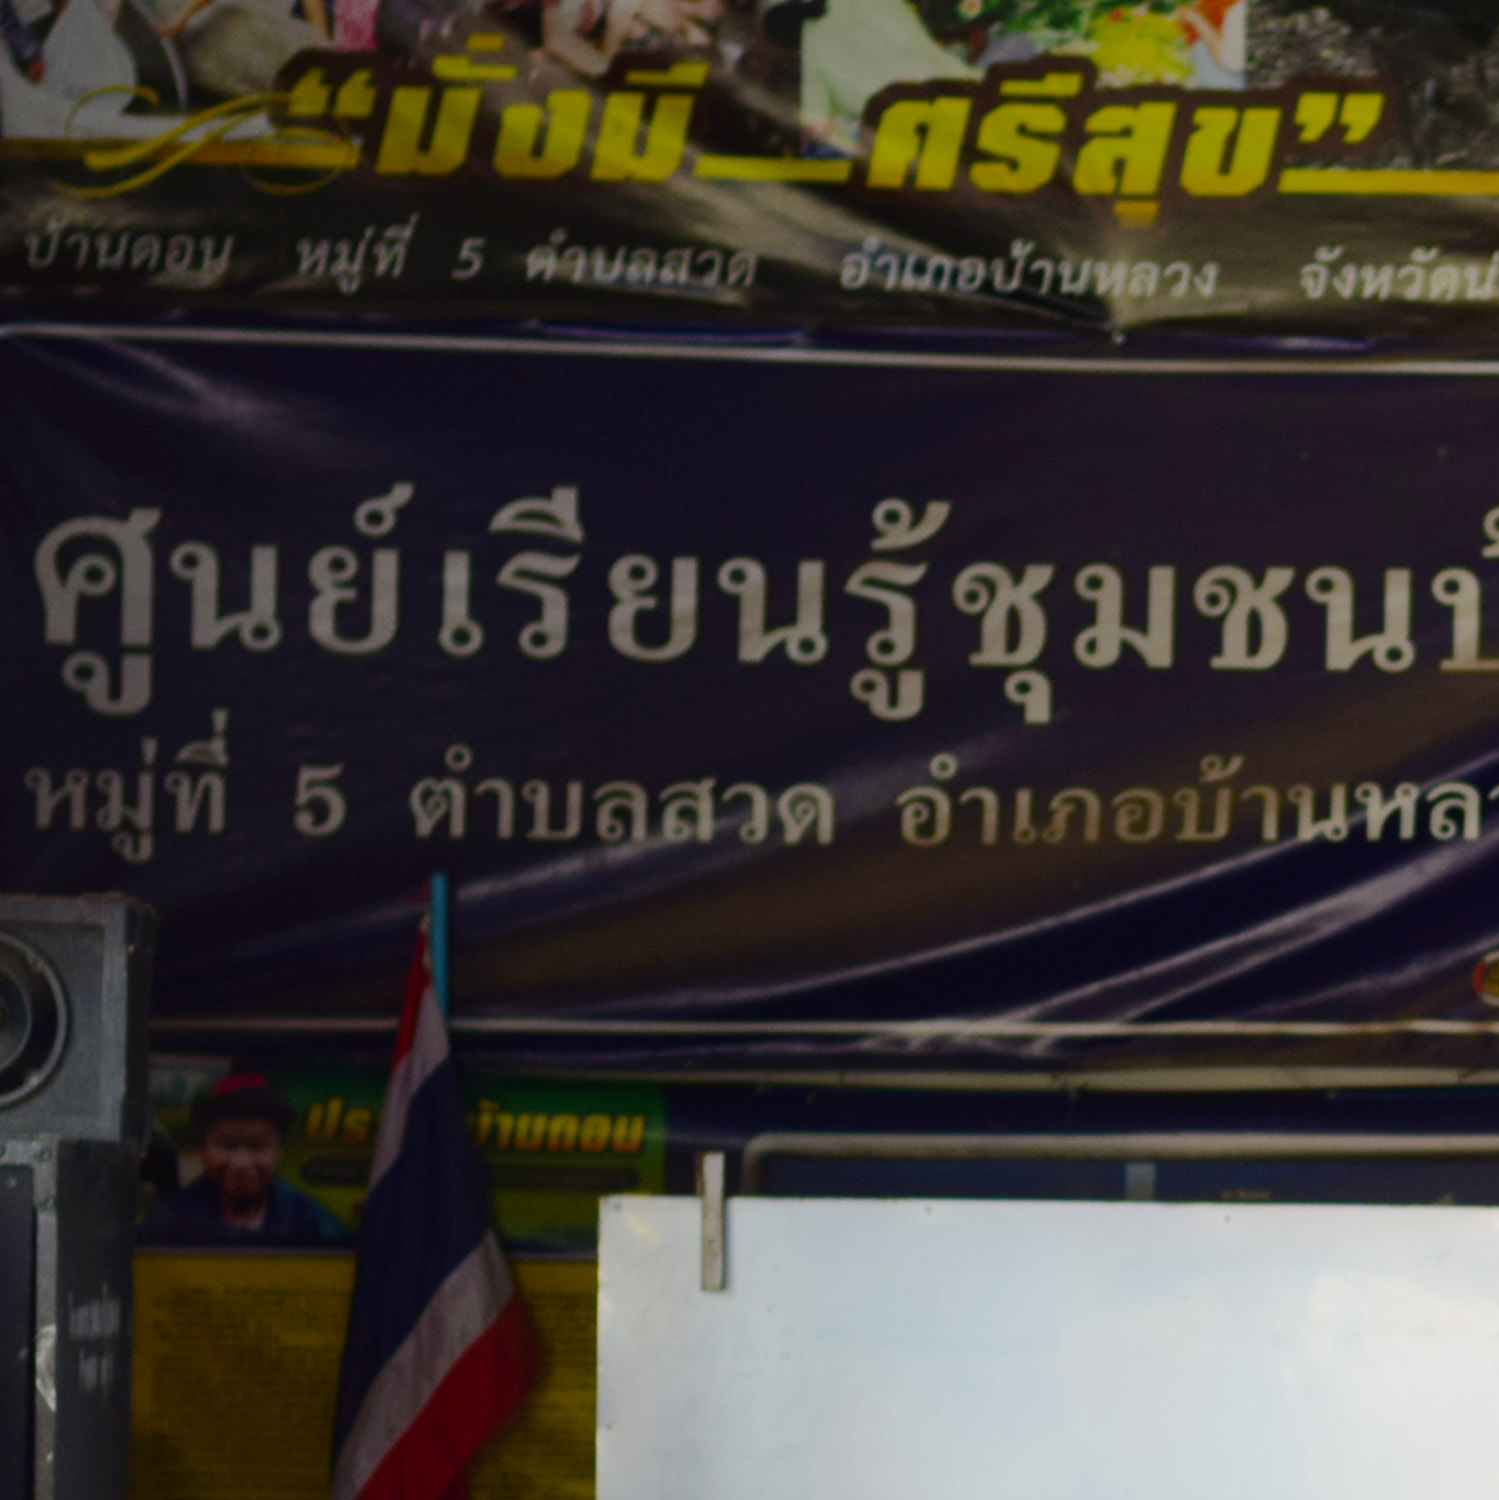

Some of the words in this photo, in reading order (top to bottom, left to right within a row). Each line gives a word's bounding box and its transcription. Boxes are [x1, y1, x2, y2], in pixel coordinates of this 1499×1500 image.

[25, 213, 234, 277] บ้านดอน
[296, 213, 421, 293] หมู่ที่
[452, 238, 486, 278] 5
[525, 234, 760, 289] ตำบลสวด
[840, 237, 1219, 298] อำเภอบ้านหลวง
[25, 708, 230, 863] หมู่ที่
[295, 760, 346, 838] 5
[410, 744, 834, 844] ตำบลสวด
